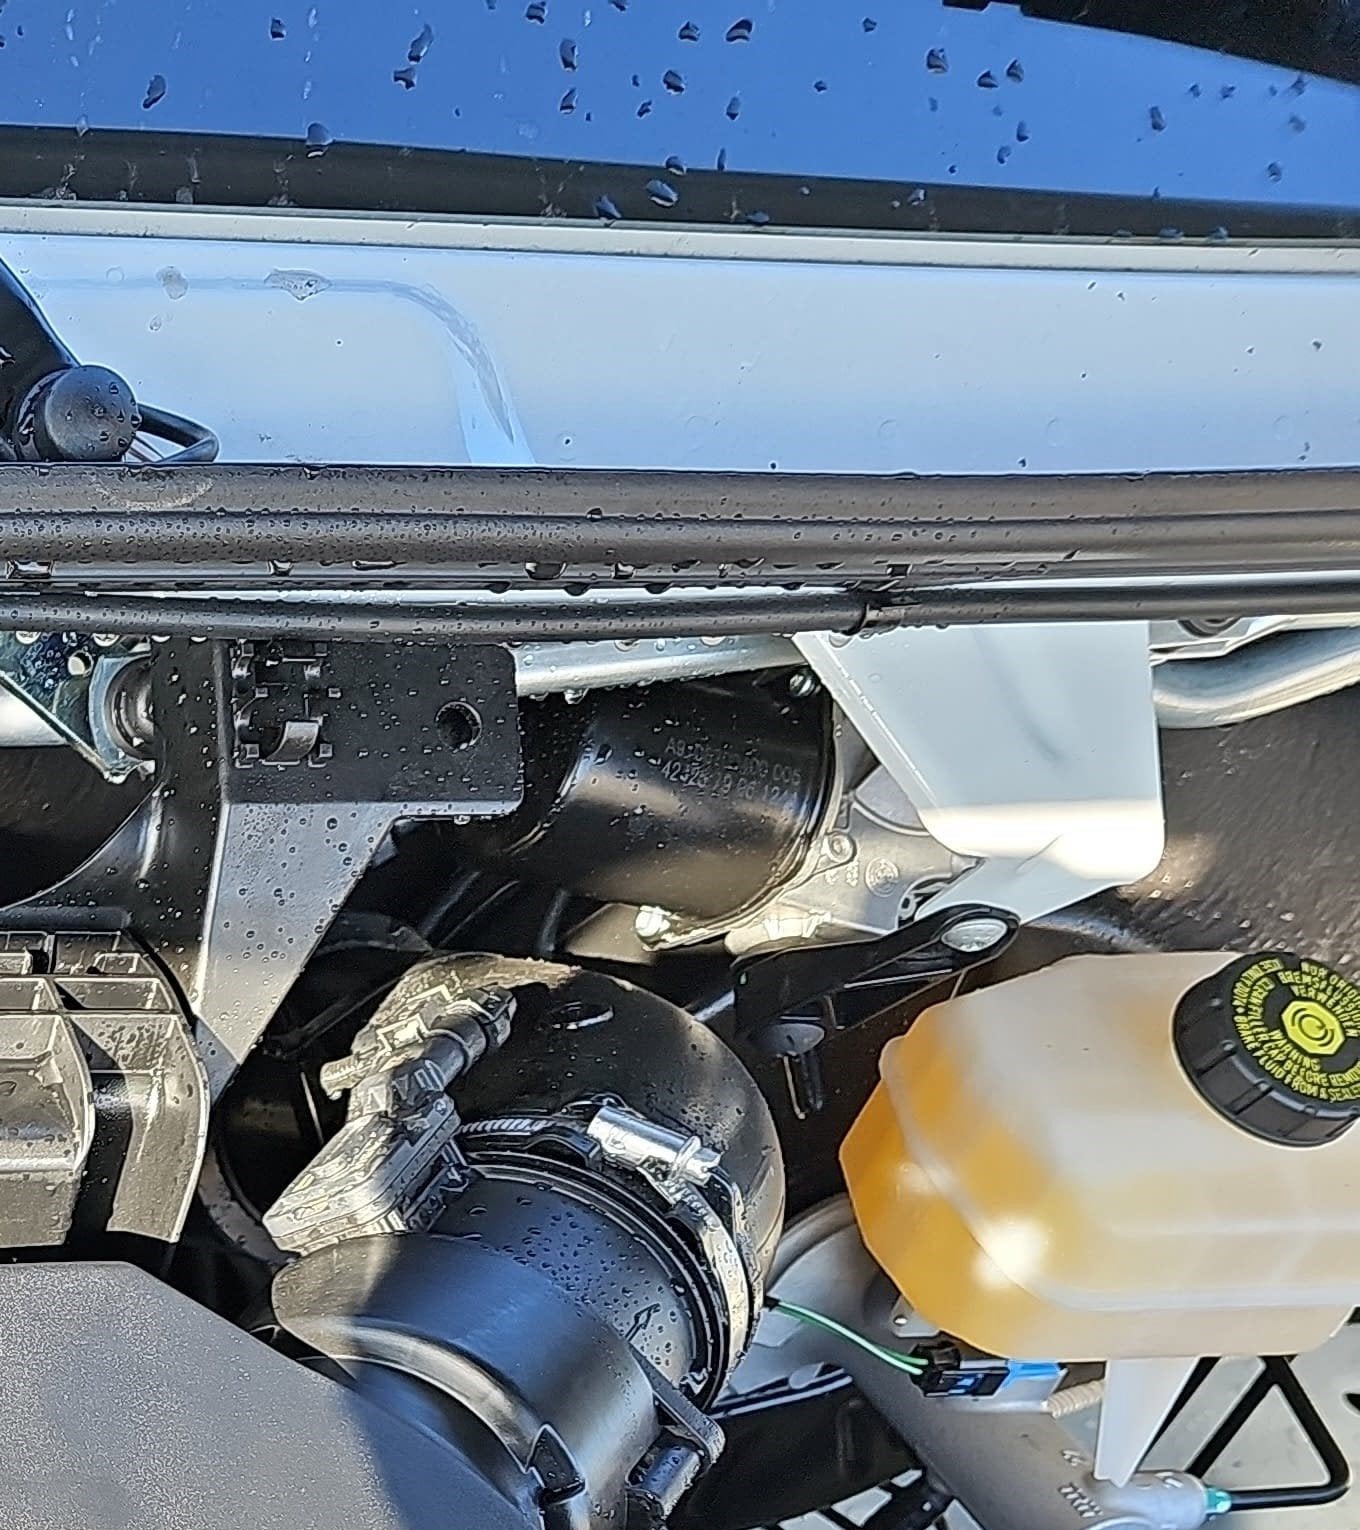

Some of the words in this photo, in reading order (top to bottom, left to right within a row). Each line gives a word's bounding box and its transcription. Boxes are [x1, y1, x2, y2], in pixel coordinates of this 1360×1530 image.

[1233, 1015, 1261, 1050] BRAKE
[1252, 1049, 1286, 1079] FLUID
[1284, 1073, 1318, 1097] FROM
[1247, 1005, 1269, 1041] FILLER
[1263, 1042, 1287, 1060] CAP
[1283, 1060, 1329, 1086] BEFORE
[1268, 1029, 1320, 1071] WARNING
